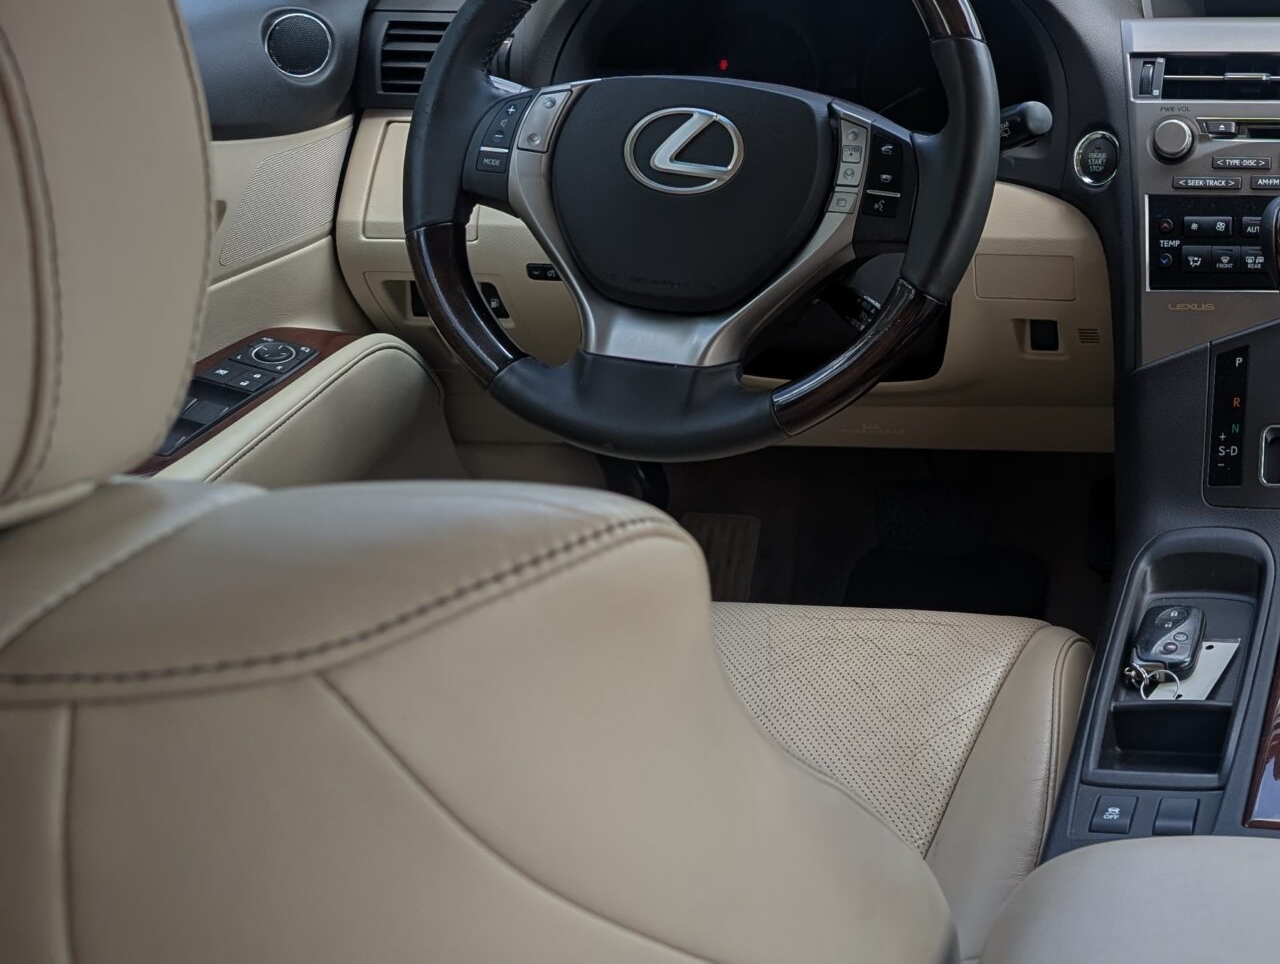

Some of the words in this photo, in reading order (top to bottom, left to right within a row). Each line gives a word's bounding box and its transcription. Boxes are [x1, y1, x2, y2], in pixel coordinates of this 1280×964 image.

[483, 157, 501, 166] MODE
[1168, 303, 1215, 311] LEXUS
[1235, 357, 1243, 367] P
[1233, 397, 1240, 407] R
[1231, 423, 1239, 433] N
